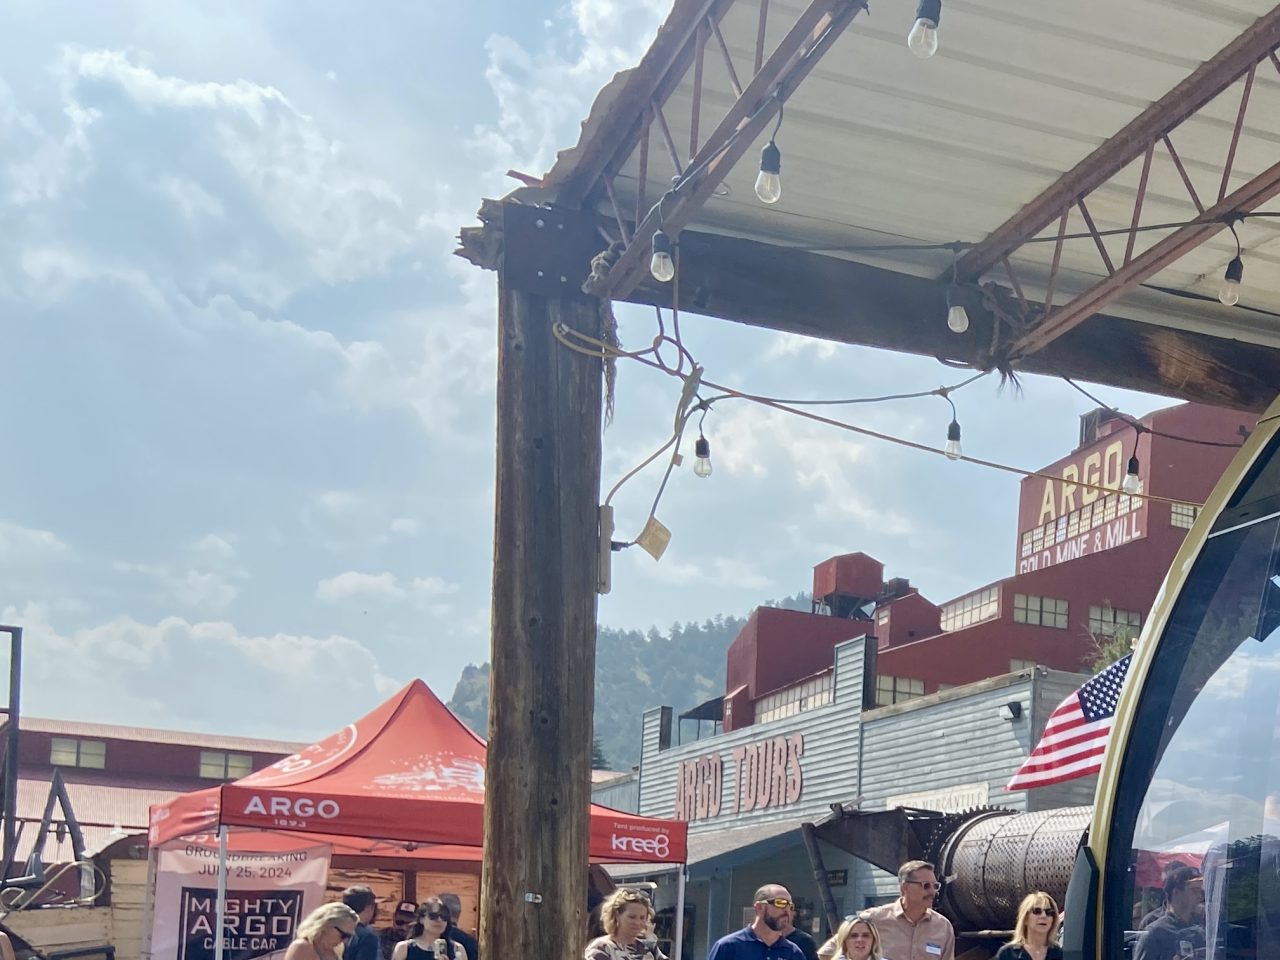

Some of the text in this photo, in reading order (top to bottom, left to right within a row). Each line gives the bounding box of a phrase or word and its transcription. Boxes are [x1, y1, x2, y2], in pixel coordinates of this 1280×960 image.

[1038, 440, 1123, 526] ARGO
[1056, 533, 1090, 565] MINE
[1094, 531, 1102, 553] &
[1105, 512, 1141, 550] MILL
[674, 731, 804, 822] ARGO TOURS
[244, 795, 340, 819] ARGO
[260, 866, 292, 879] 2024
[191, 915, 292, 936] ARGO
[251, 938, 278, 950] CAR
